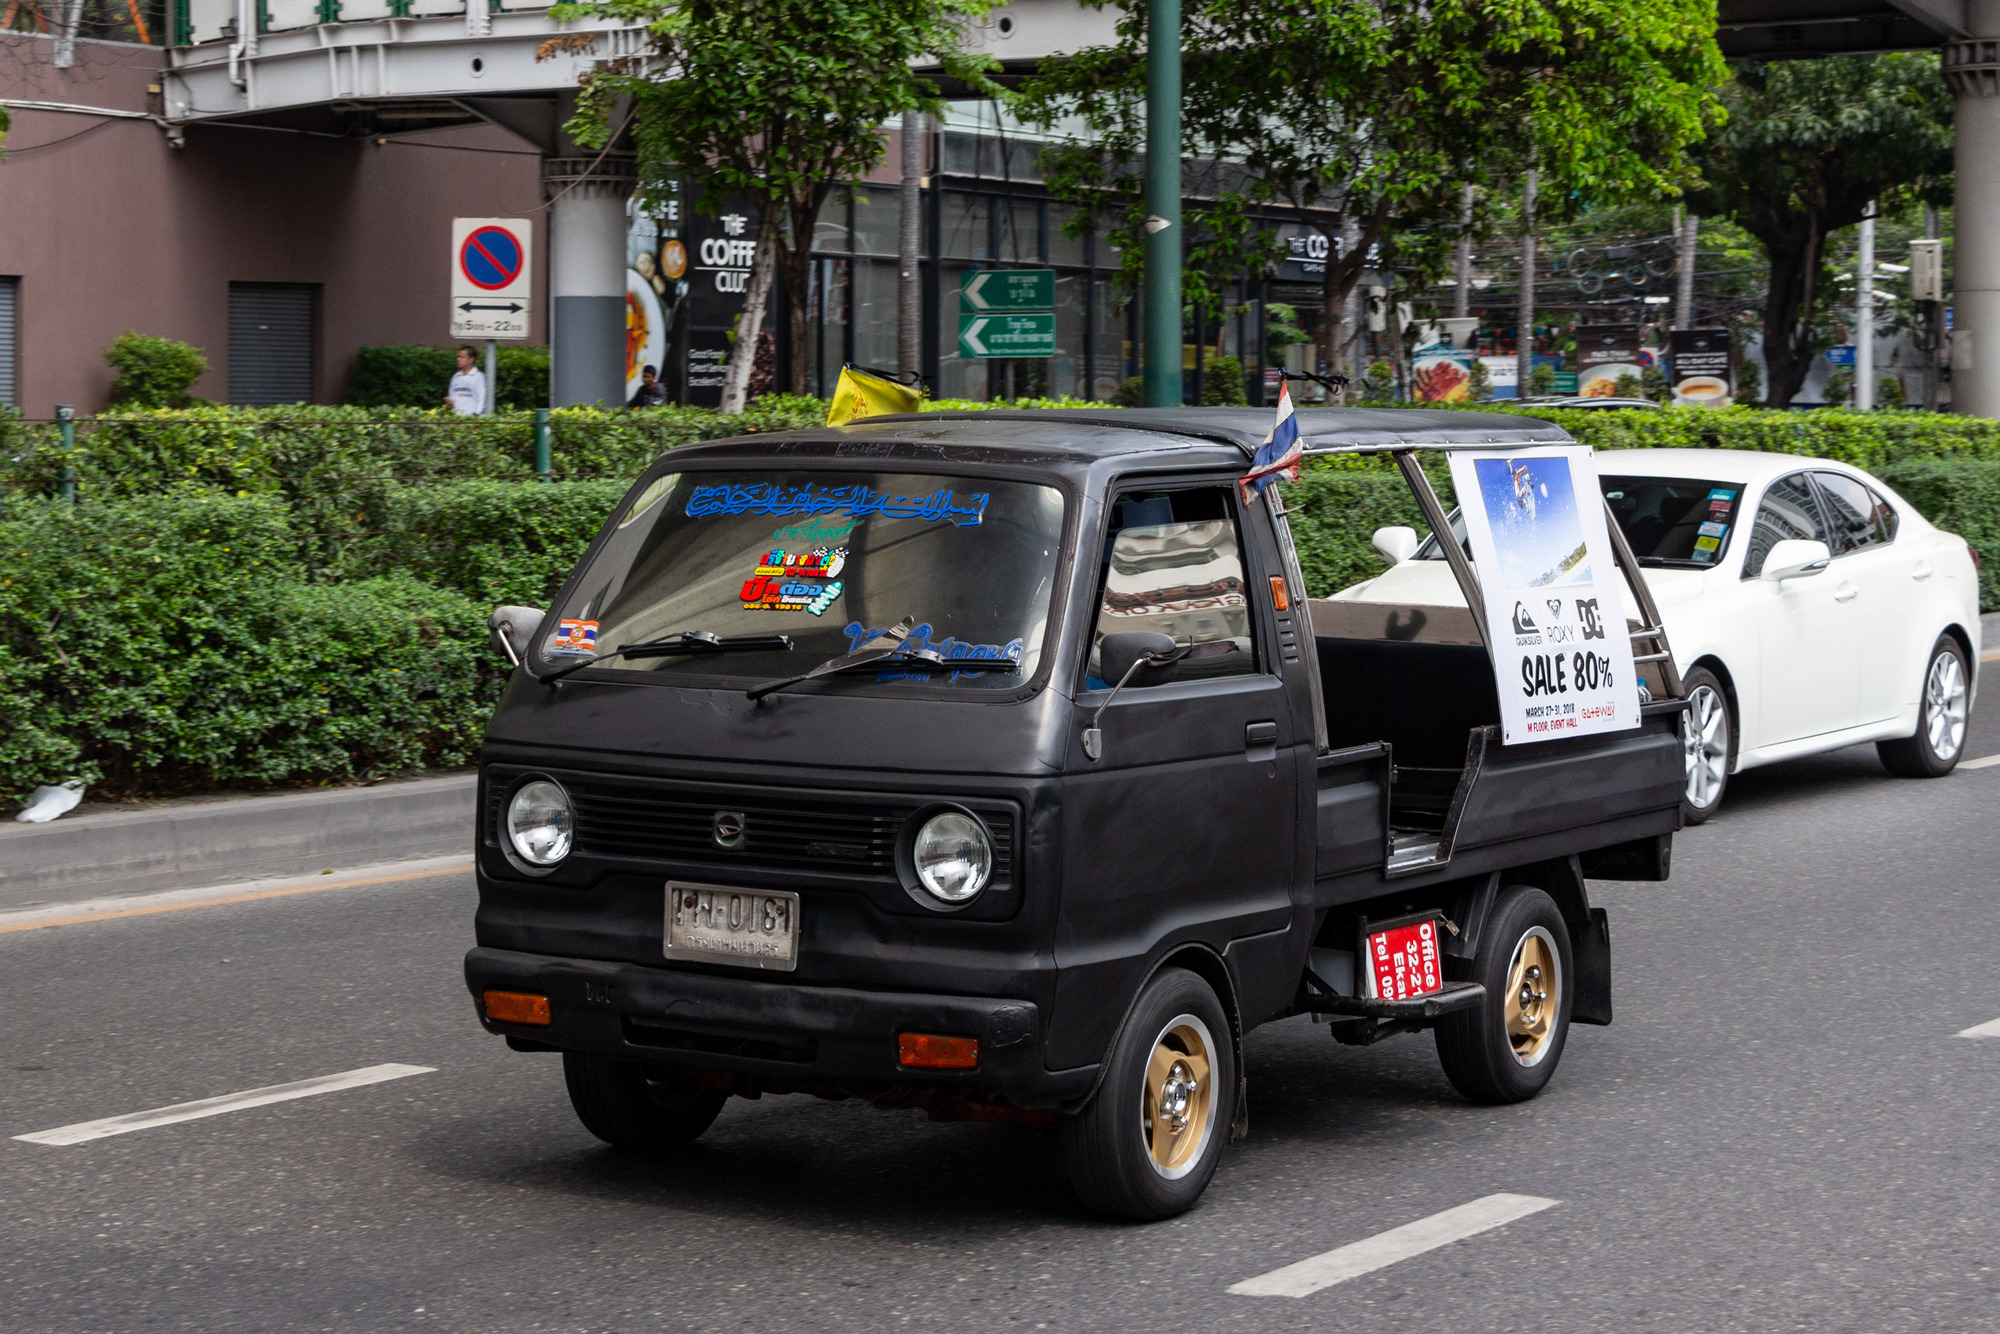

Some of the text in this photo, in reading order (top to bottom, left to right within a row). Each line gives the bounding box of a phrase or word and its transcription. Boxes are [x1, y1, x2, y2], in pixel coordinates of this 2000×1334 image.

[700, 238, 757, 266] COFFE
[1515, 625, 1574, 646] QUIKSILVER ROXY
[1522, 651, 1613, 697] SALE 80%
[1525, 706, 1545, 719] MARCH
[1563, 703, 1575, 714] 2018
[1527, 723, 1533, 733] M
[1550, 720, 1565, 730] EVENT
[1566, 718, 1577, 728] HALL
[1375, 932, 1389, 961] Tel
[1420, 923, 1435, 987] Office
[1381, 976, 1394, 1000] 09
